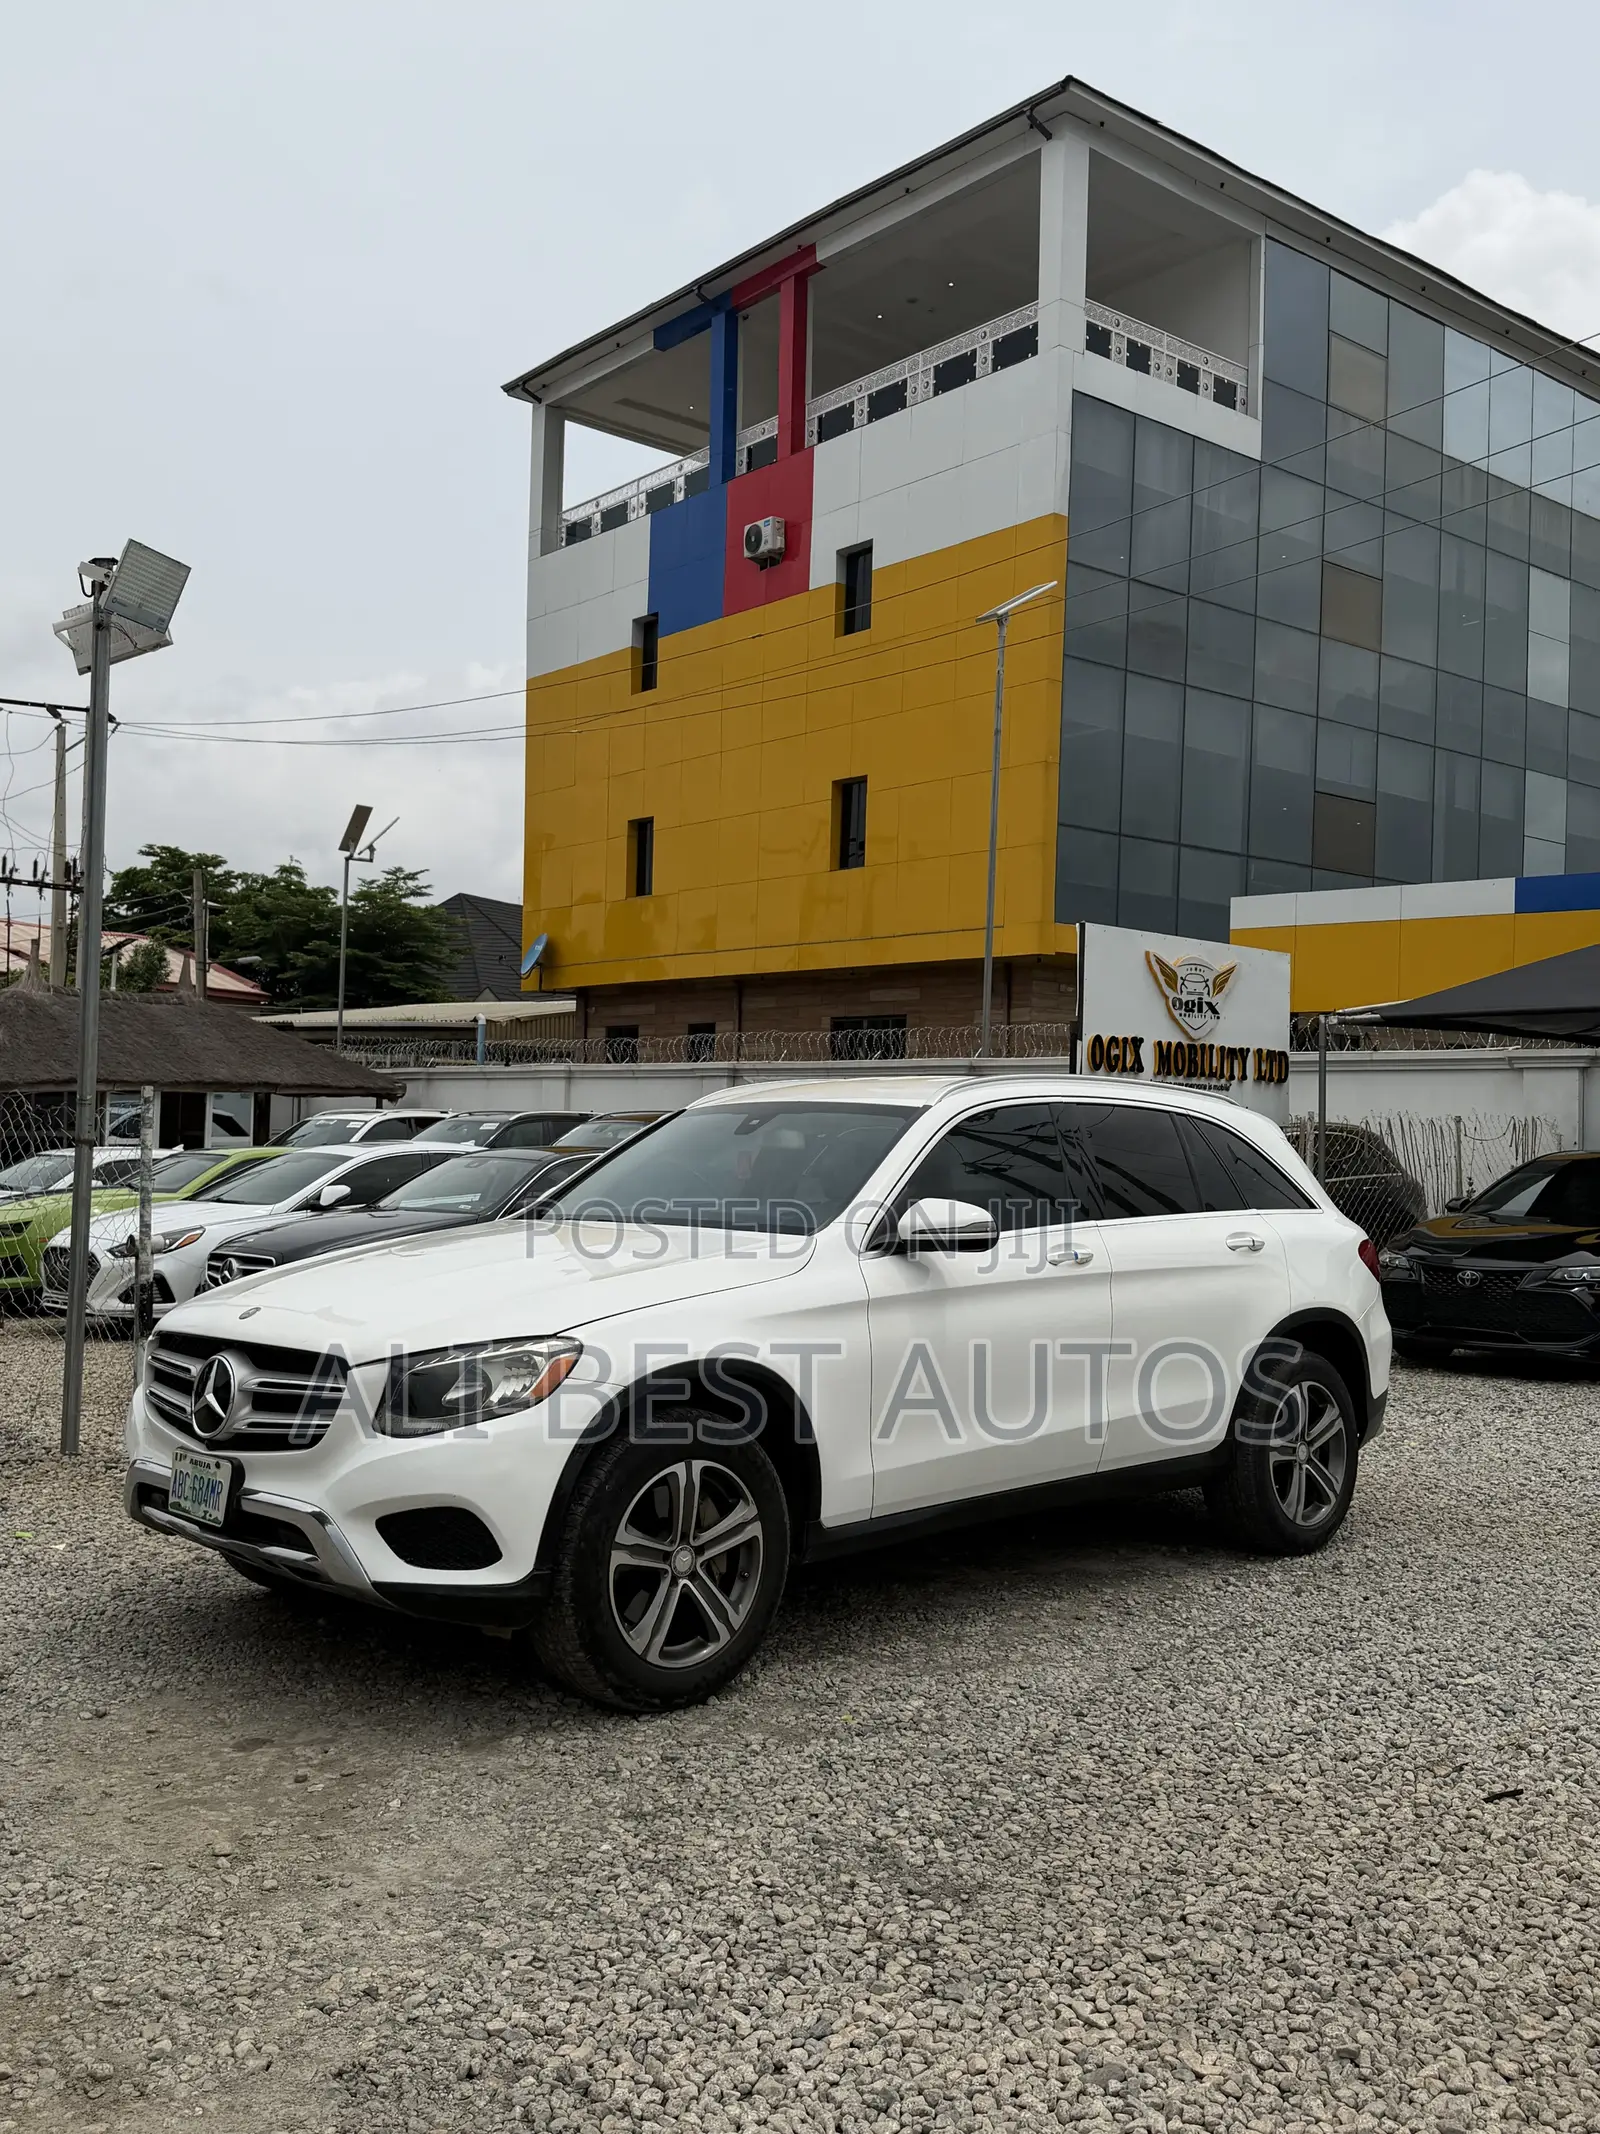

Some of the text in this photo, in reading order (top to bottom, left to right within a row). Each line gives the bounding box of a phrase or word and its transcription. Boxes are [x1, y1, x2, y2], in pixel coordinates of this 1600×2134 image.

[1087, 1034, 1290, 1084] OGIX MOBILITY LTD
[190, 1459, 211, 1469] ABUJA
